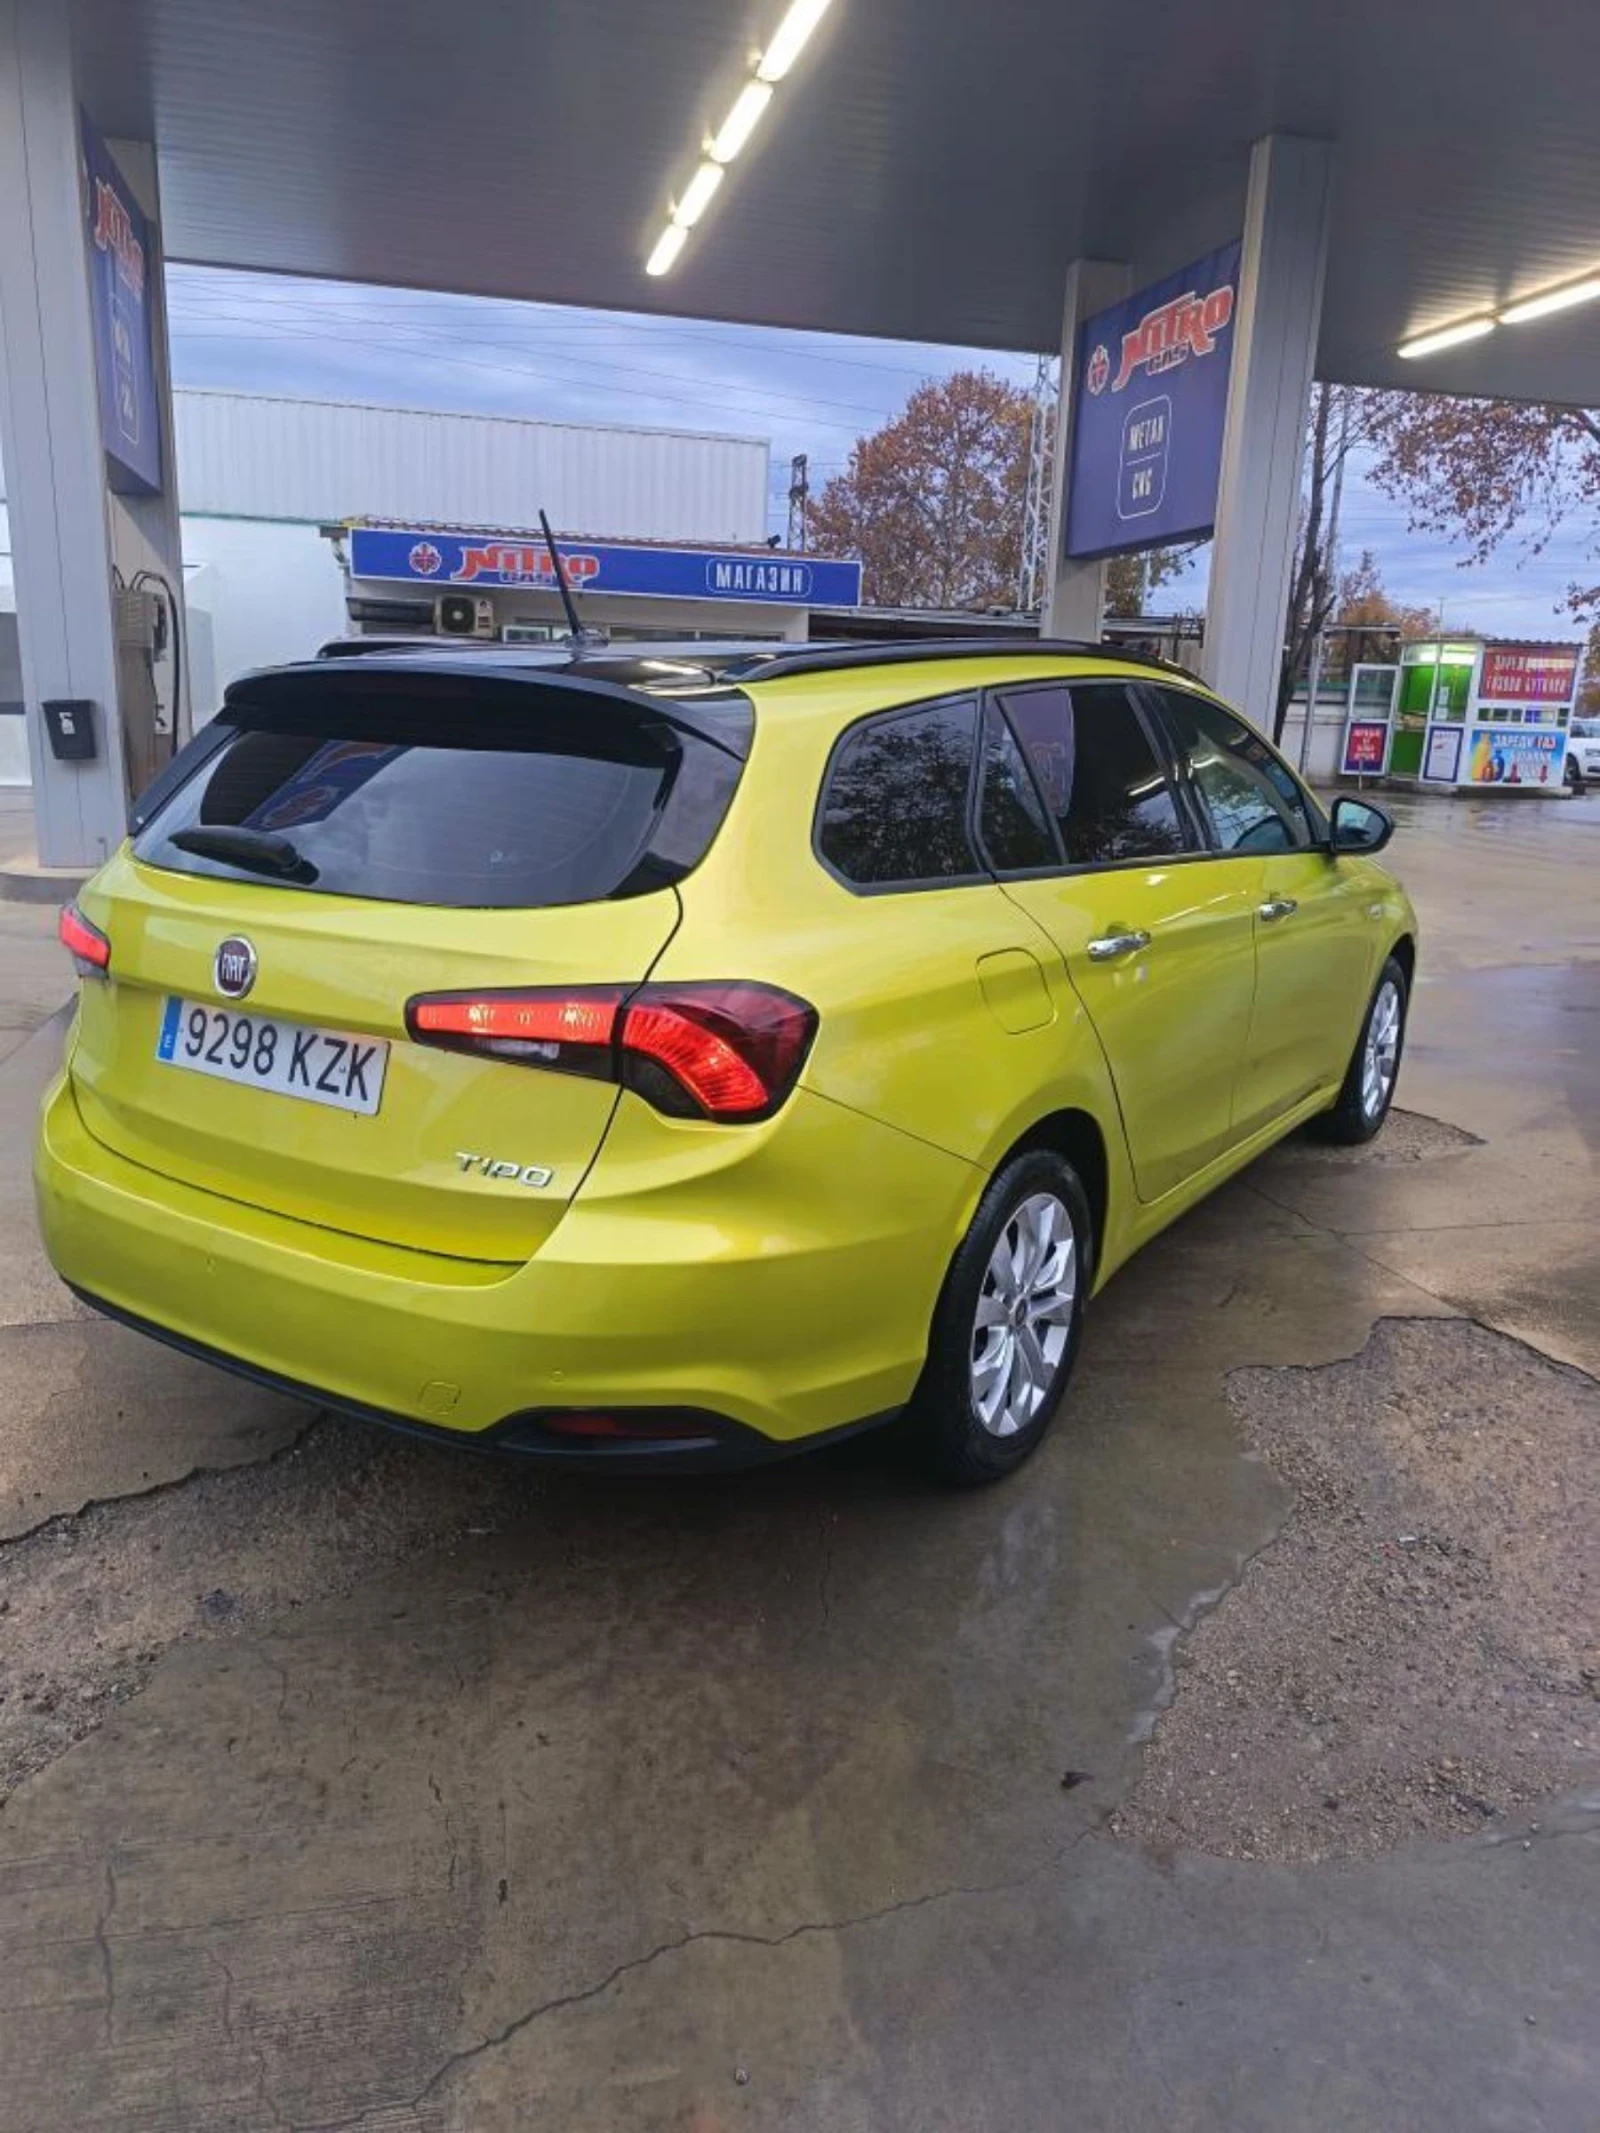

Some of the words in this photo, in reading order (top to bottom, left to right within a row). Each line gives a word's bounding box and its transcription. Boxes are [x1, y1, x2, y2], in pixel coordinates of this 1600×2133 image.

[716, 562, 803, 593] МАГАЗИН
[222, 952, 247, 982] FIAT
[184, 1008, 278, 1076] 9298
[288, 1031, 377, 1102] KZK
[456, 1151, 553, 1189] TIPO
